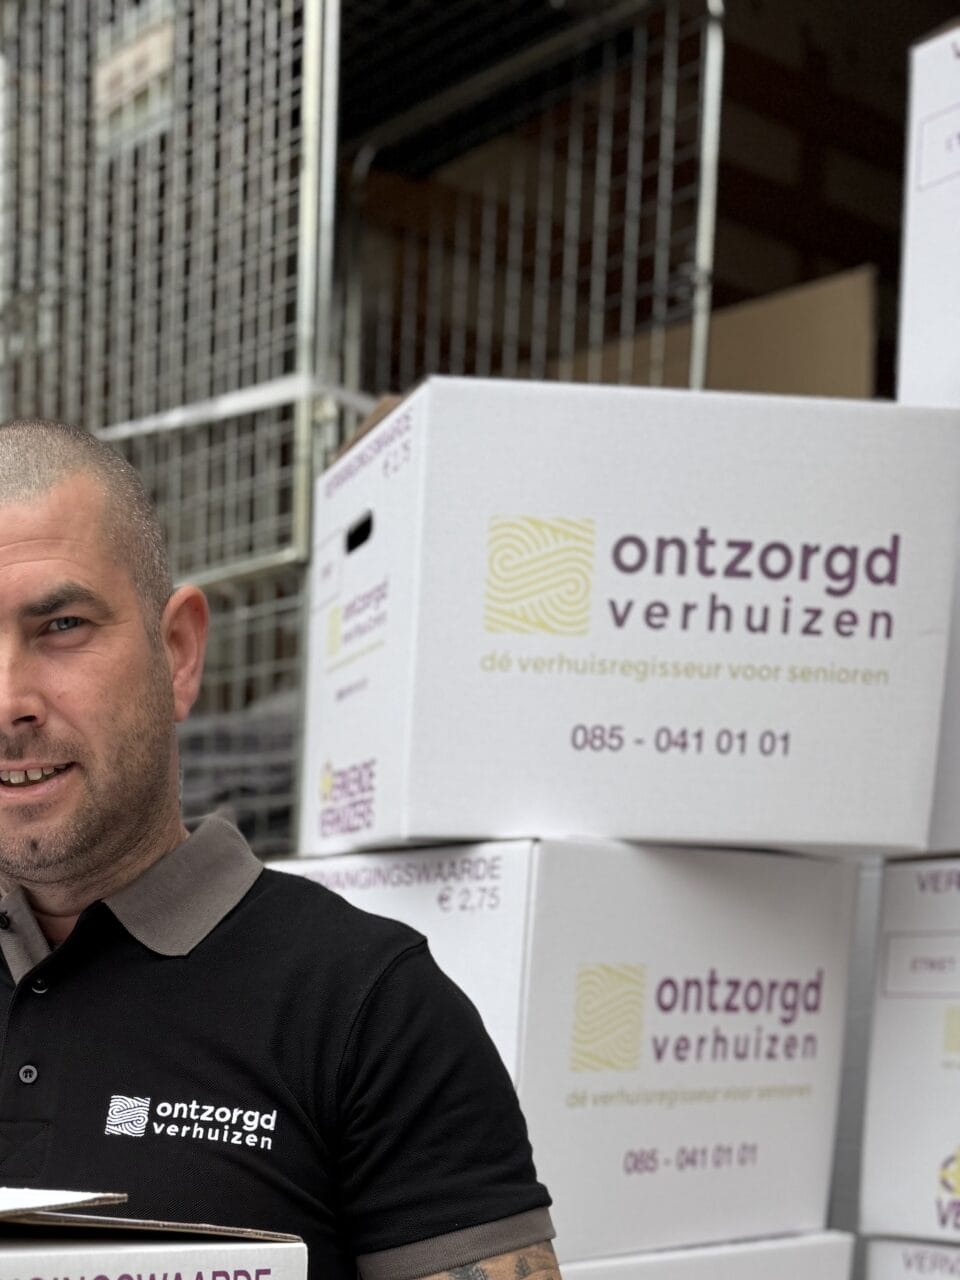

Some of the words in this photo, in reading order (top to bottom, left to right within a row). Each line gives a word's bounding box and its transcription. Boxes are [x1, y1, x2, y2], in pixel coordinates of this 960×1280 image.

[612, 527, 900, 597] ontzorgd
[608, 593, 893, 639] verhuizen
[480, 650, 513, 672] dé
[518, 653, 722, 683] verhuisregisseur
[728, 663, 780, 682] voor
[788, 661, 890, 685] senioren
[570, 724, 625, 752] 085
[654, 728, 704, 754] 041
[716, 729, 746, 755] 01
[758, 731, 790, 757] 01
[655, 967, 824, 1025] ontzorgd
[651, 1024, 819, 1063] verhuizen
[156, 1100, 277, 1131] ontzorgd
[153, 1122, 272, 1150] verhuizen
